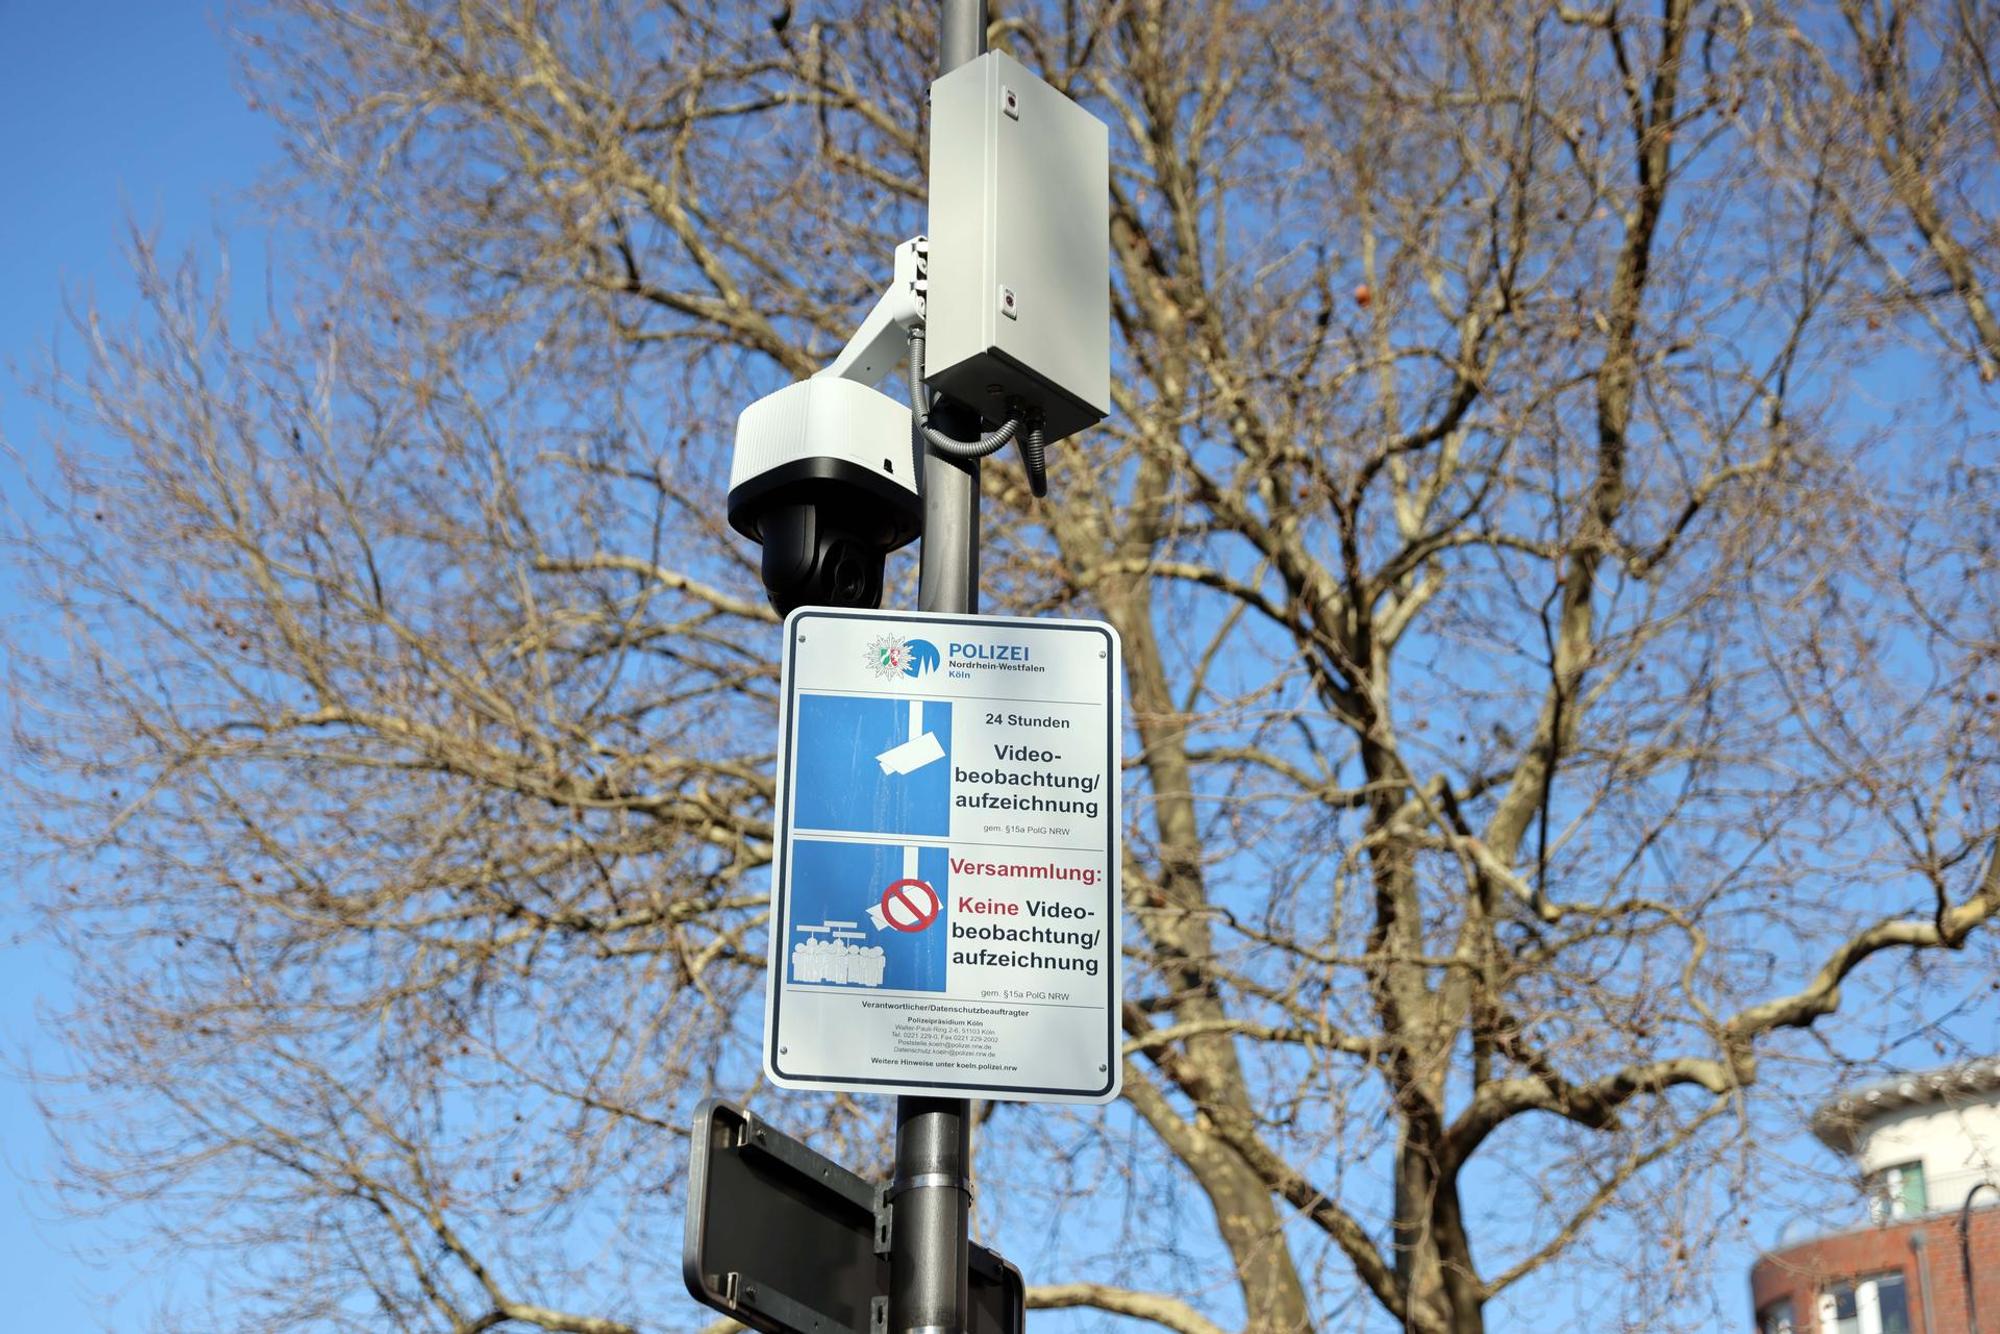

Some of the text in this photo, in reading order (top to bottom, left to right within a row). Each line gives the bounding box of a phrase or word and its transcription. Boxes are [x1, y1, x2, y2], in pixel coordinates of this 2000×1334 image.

[949, 643, 1029, 661] POLIZEI
[949, 660, 1045, 672] Nordrhein-Westfalen
[949, 670, 970, 679] Köln
[985, 713, 1070, 728] 24 Stunden
[994, 744, 1061, 763] Video-
[955, 767, 1100, 793] beobachtung/
[955, 792, 1098, 818] aufzeichnung
[983, 825, 1070, 836] gem. §15a PolG NRW
[950, 858, 1102, 885] Versammlung:
[958, 896, 1095, 919] Keine Video-
[952, 922, 1100, 949] beobachtung/
[952, 949, 1098, 976] aufzeichnung
[981, 989, 1070, 1001] gem. §15a PolG NRW
[861, 1000, 1030, 1017] Verantwortlicher/Datenschutzbeauftragter
[907, 1016, 965, 1025] Polizeipräsidium
[871, 1057, 899, 1065] Weitere
[900, 1058, 934, 1066] Hinweise
[956, 1061, 1018, 1071] koeln.polizei.nrw
